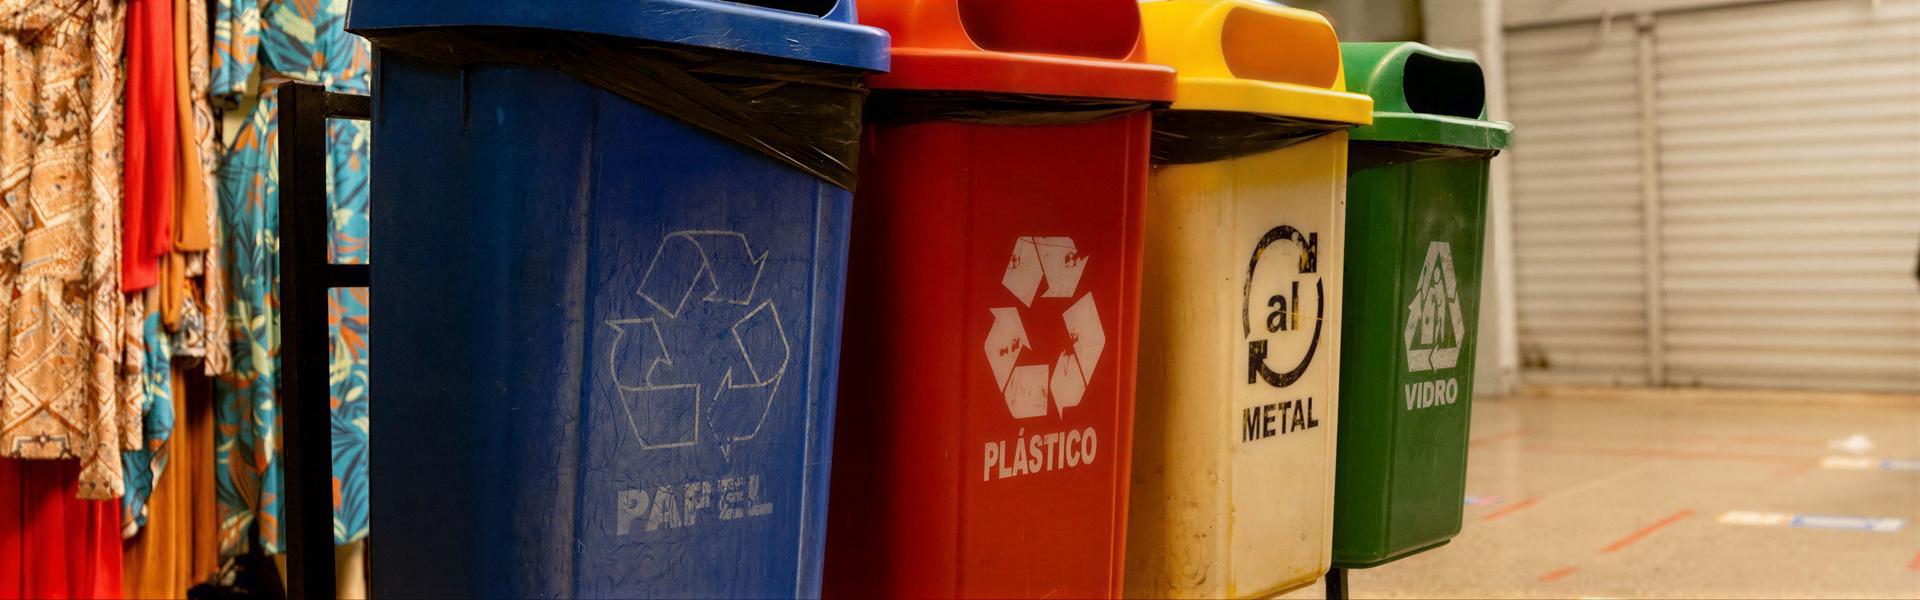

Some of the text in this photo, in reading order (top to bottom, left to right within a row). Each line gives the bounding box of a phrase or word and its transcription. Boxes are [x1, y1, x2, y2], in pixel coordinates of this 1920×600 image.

[1266, 281, 1299, 334] al
[1242, 397, 1319, 443] METAL
[1404, 378, 1458, 411] VIDRO
[983, 427, 1098, 482] PLÁSTICO
[616, 475, 773, 536] PAPEL
